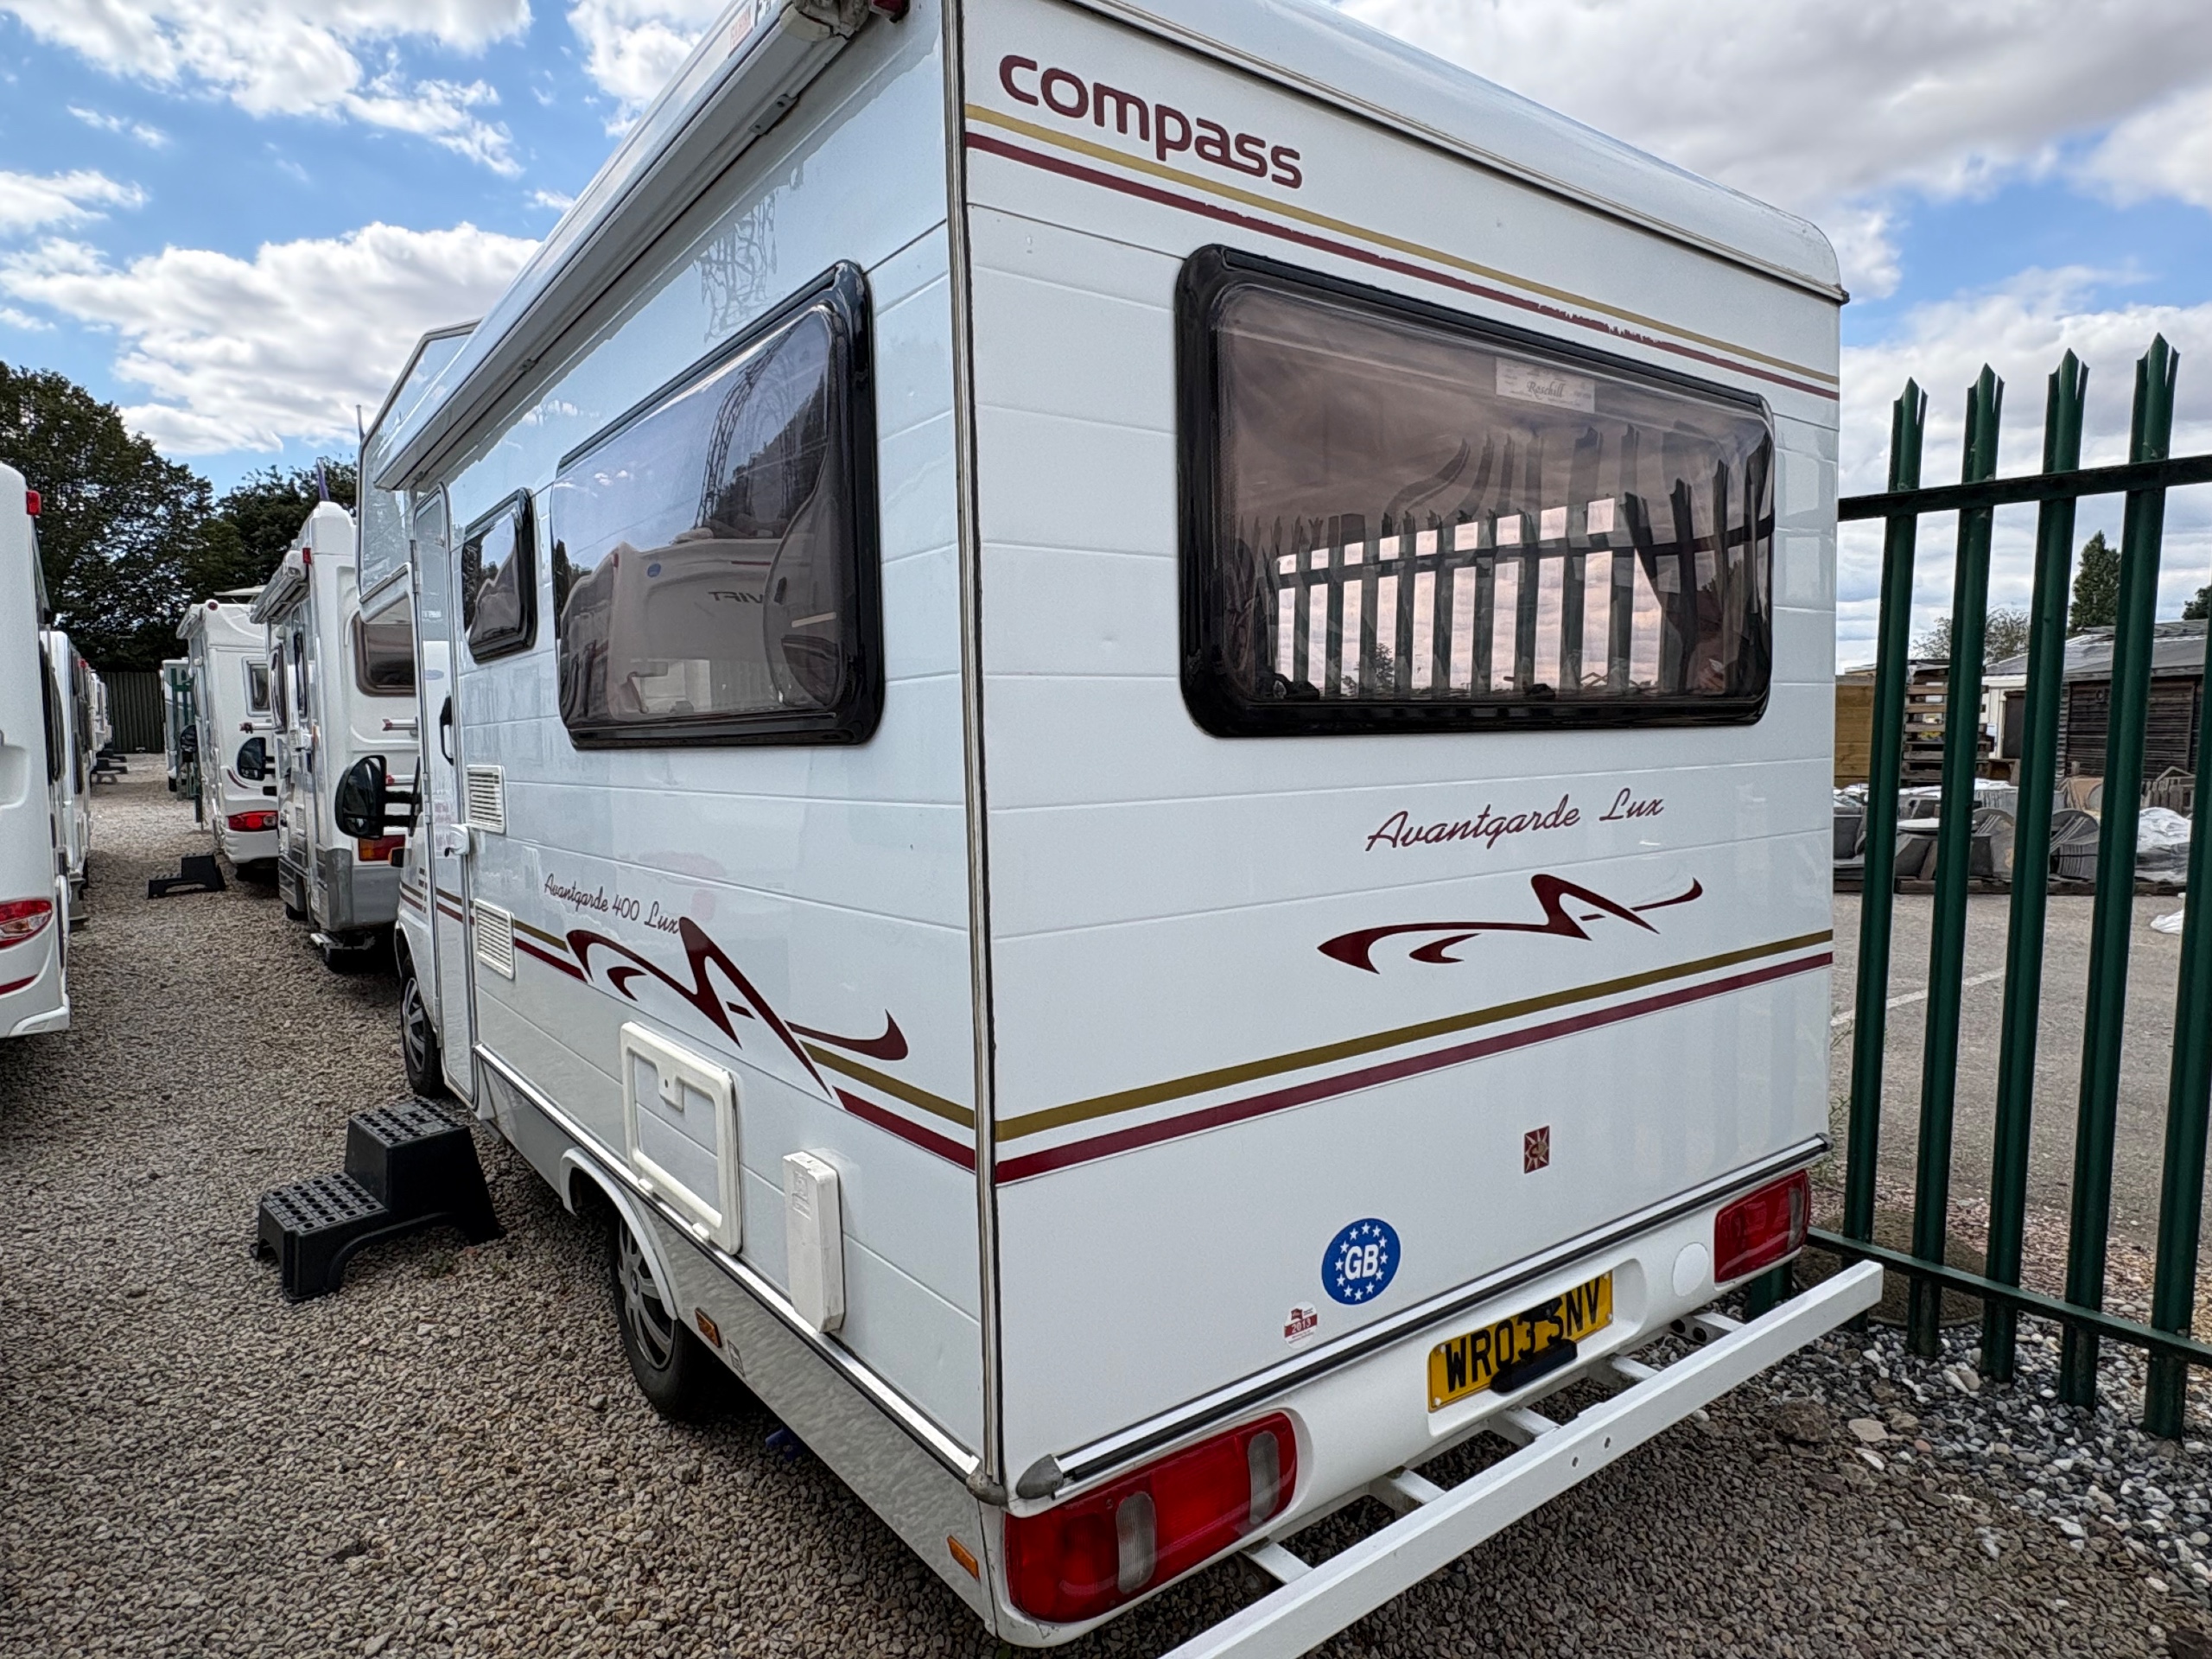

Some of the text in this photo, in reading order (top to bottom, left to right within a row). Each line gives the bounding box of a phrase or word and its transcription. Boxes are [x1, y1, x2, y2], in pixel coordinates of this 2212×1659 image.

[999, 54, 1303, 189] compass
[1365, 787, 1664, 851] Avantgarde Lux
[544, 873, 679, 934] Avantgarde 400 Lux
[1344, 1243, 1380, 1281] GB
[1291, 1318, 1312, 1333] 2013
